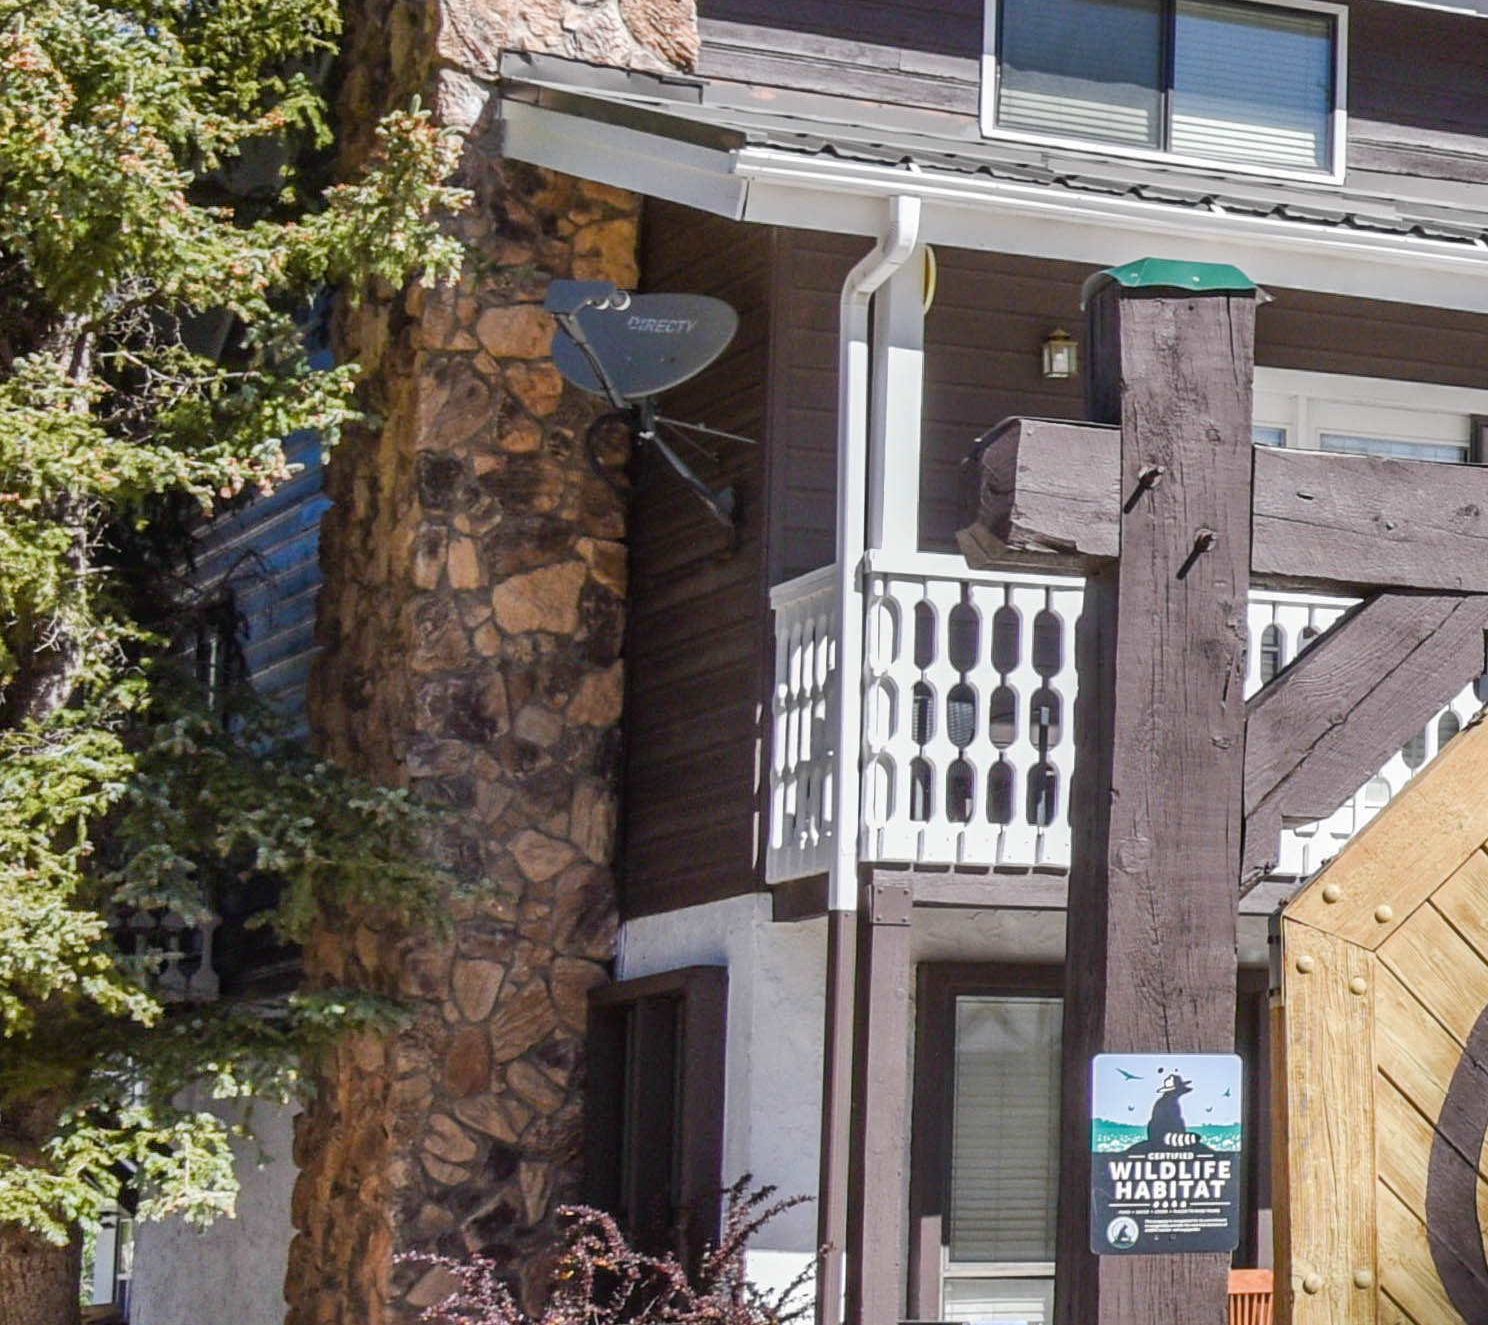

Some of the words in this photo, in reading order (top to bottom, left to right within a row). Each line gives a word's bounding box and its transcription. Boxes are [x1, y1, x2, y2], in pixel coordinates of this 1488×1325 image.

[627, 316, 697, 334] DIRECTV
[1108, 1160, 1232, 1180] WILDLIFE
[1115, 1180, 1226, 1200] HABITAT
